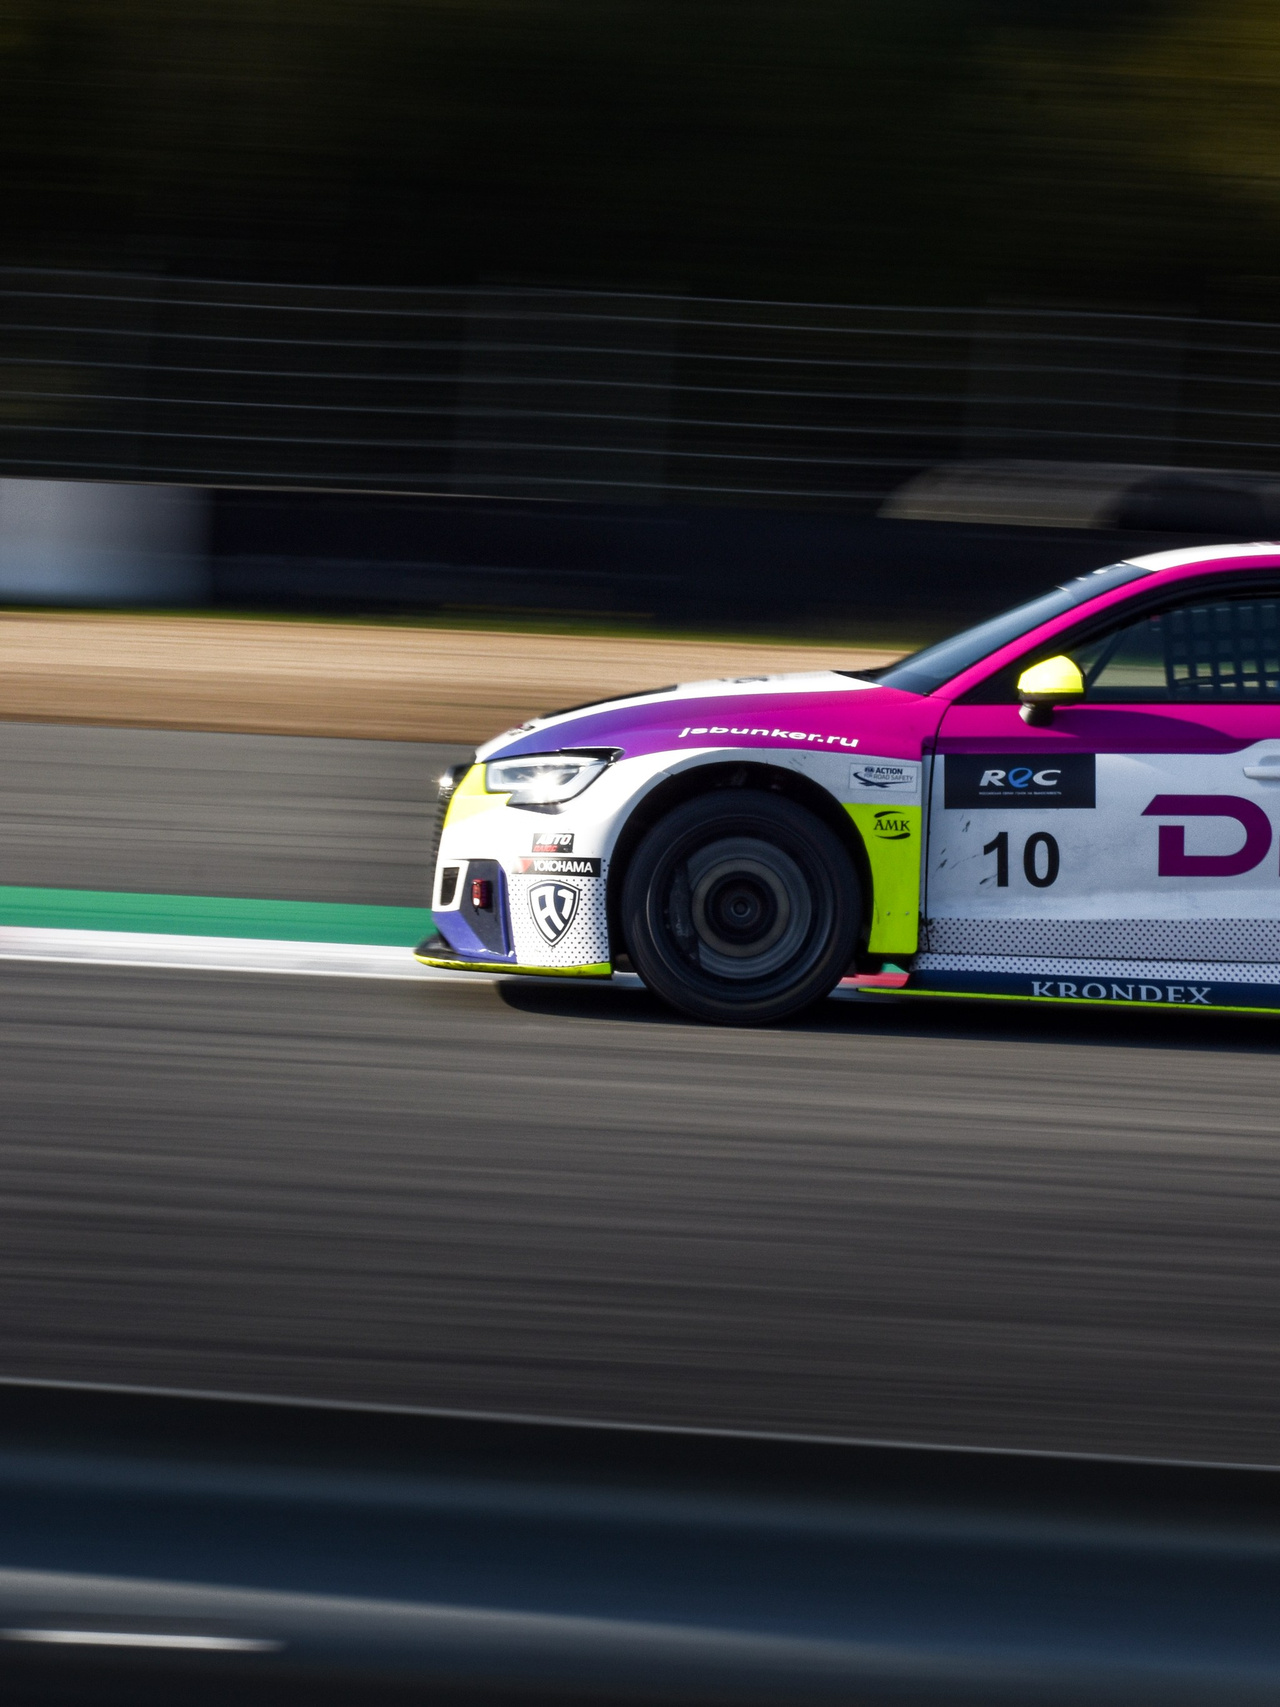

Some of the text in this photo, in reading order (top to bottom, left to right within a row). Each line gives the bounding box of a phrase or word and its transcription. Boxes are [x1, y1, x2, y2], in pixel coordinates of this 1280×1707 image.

[678, 726, 859, 748] jsbunker.ru
[875, 767, 903, 775] ACTION
[873, 819, 911, 832] AMK
[533, 859, 594, 874] YOKOHAMA
[983, 831, 1060, 888] 10
[1031, 981, 1212, 1004] KRONDEX
